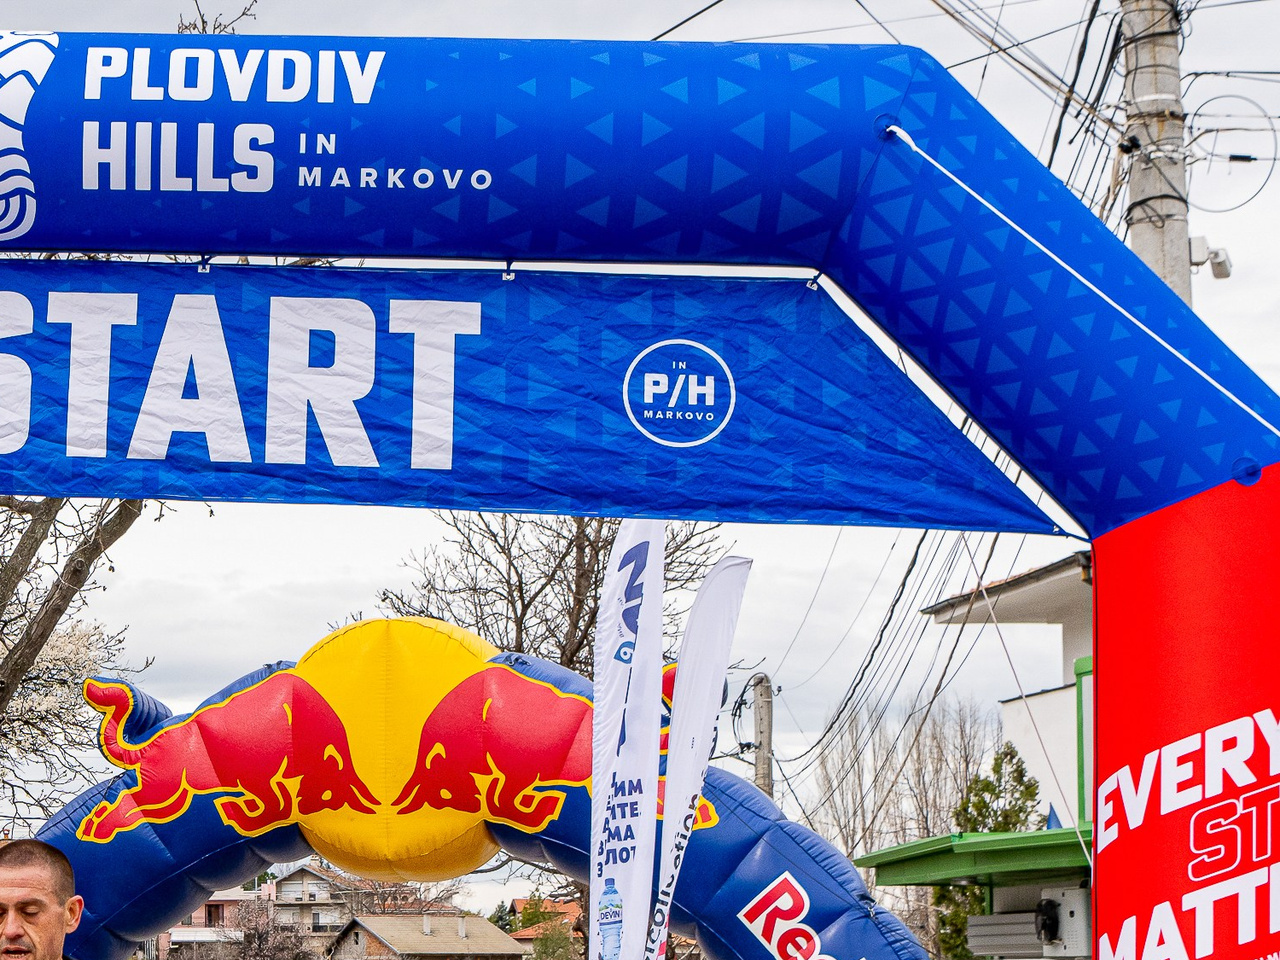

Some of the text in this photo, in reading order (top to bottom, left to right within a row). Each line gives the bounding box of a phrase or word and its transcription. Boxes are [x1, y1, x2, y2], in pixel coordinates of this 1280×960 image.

[85, 46, 385, 104] PLOVDIV
[298, 132, 337, 155] IN
[82, 120, 274, 193] HILLS
[298, 167, 494, 190] MARKOVO
[672, 361, 687, 369] IN
[643, 372, 715, 408] P/H
[643, 410, 715, 420] MARKOVO
[1097, 709, 1280, 853] EVERY
[600, 911, 621, 920] DEVIN
